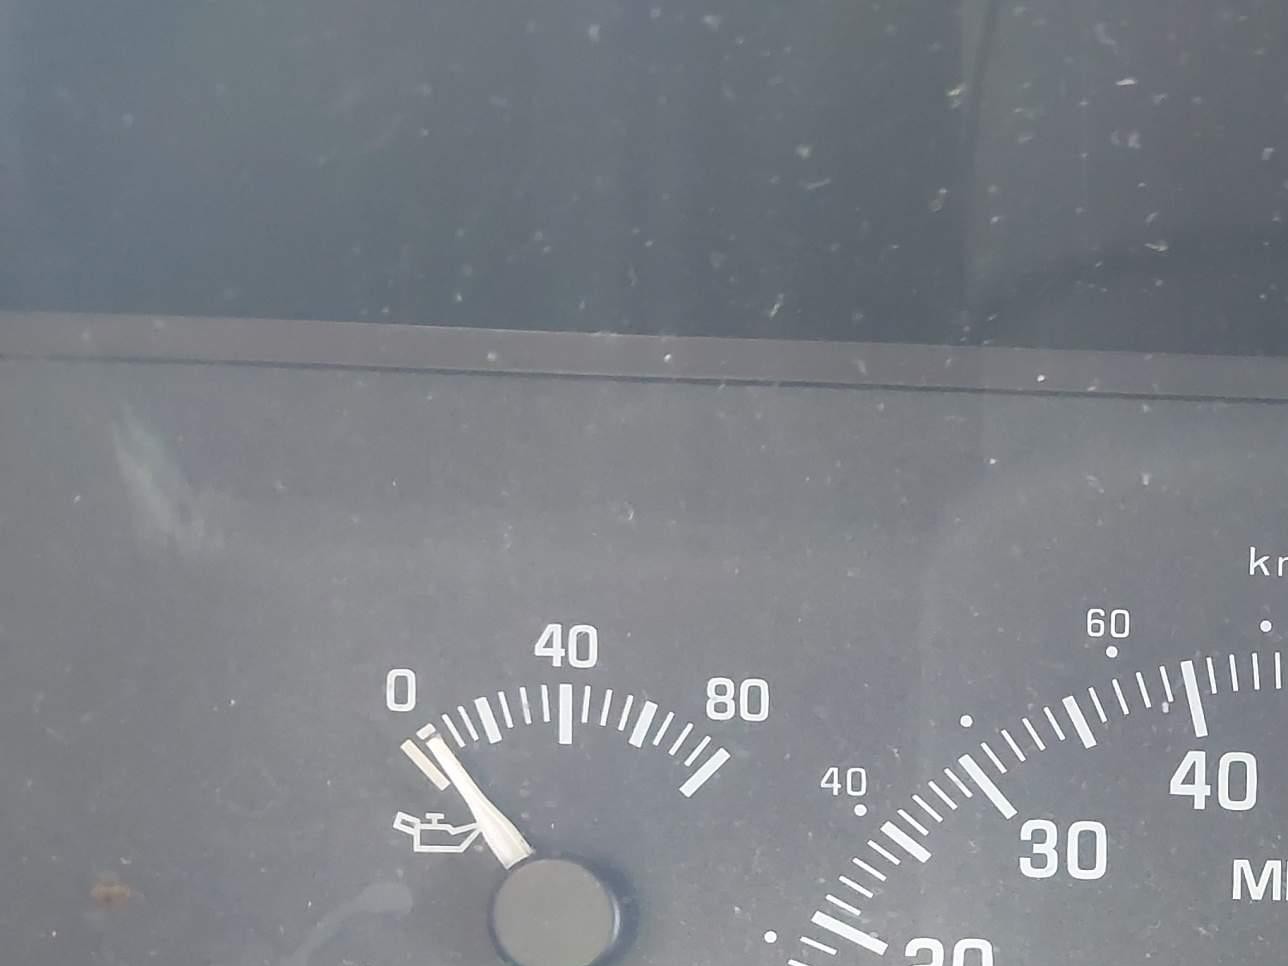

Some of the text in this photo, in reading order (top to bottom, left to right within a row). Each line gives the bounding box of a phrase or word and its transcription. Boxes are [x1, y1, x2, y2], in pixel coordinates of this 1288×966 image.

[1088, 609, 1129, 637] 60
[535, 624, 597, 667] 40
[387, 669, 415, 711] 0
[707, 678, 769, 721] 80
[821, 768, 866, 795] 40
[1170, 751, 1257, 810] 40
[1020, 820, 1106, 879] 30
